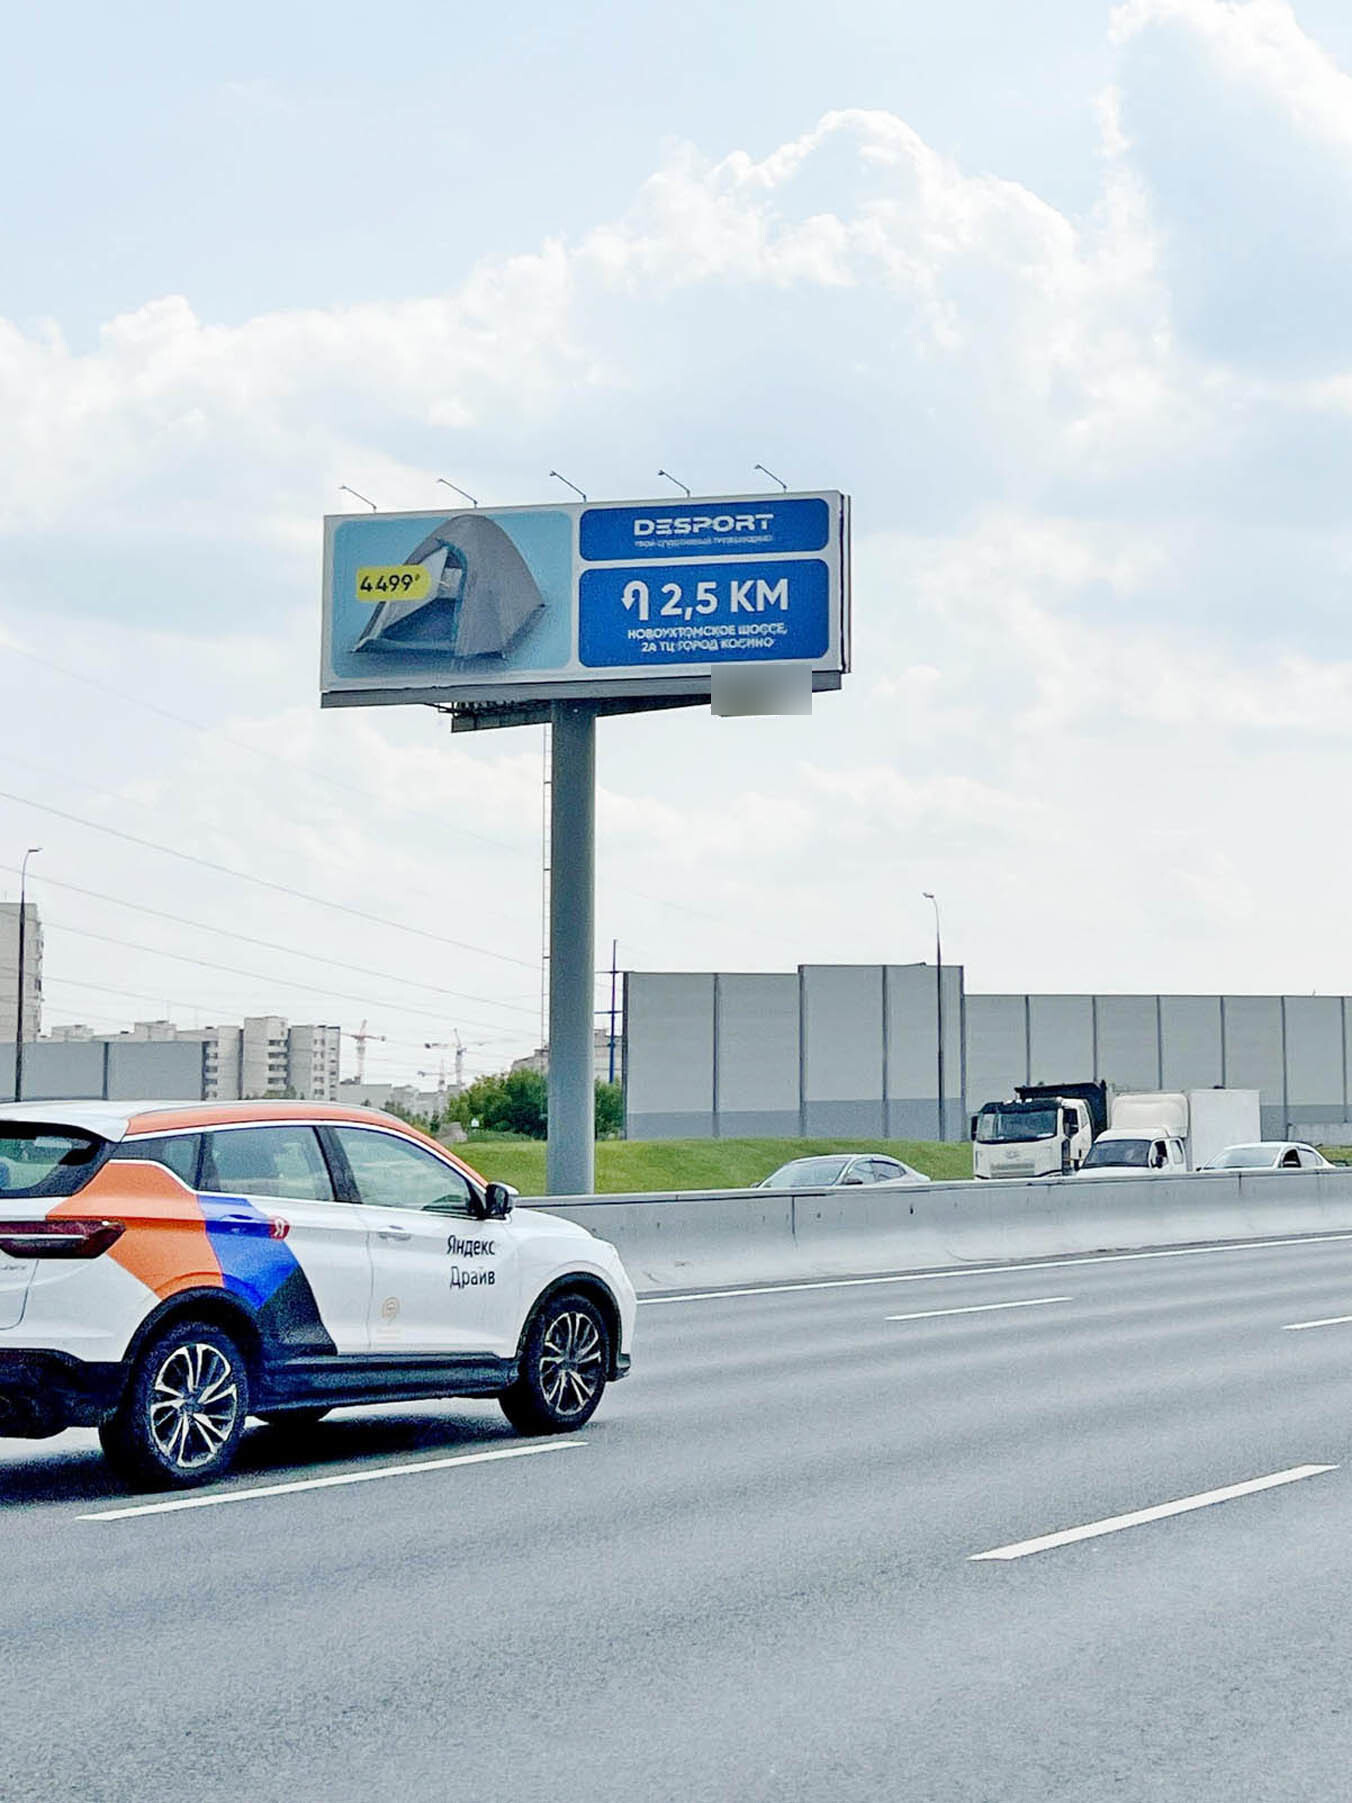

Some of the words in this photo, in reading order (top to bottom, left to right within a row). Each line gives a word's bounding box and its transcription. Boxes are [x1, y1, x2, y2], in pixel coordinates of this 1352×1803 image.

[633, 513, 775, 536] DESPORT
[660, 581, 719, 621] 2,5
[730, 578, 789, 613] КМ
[446, 1234, 495, 1258] Яндекс
[450, 1265, 495, 1289] Драйв
